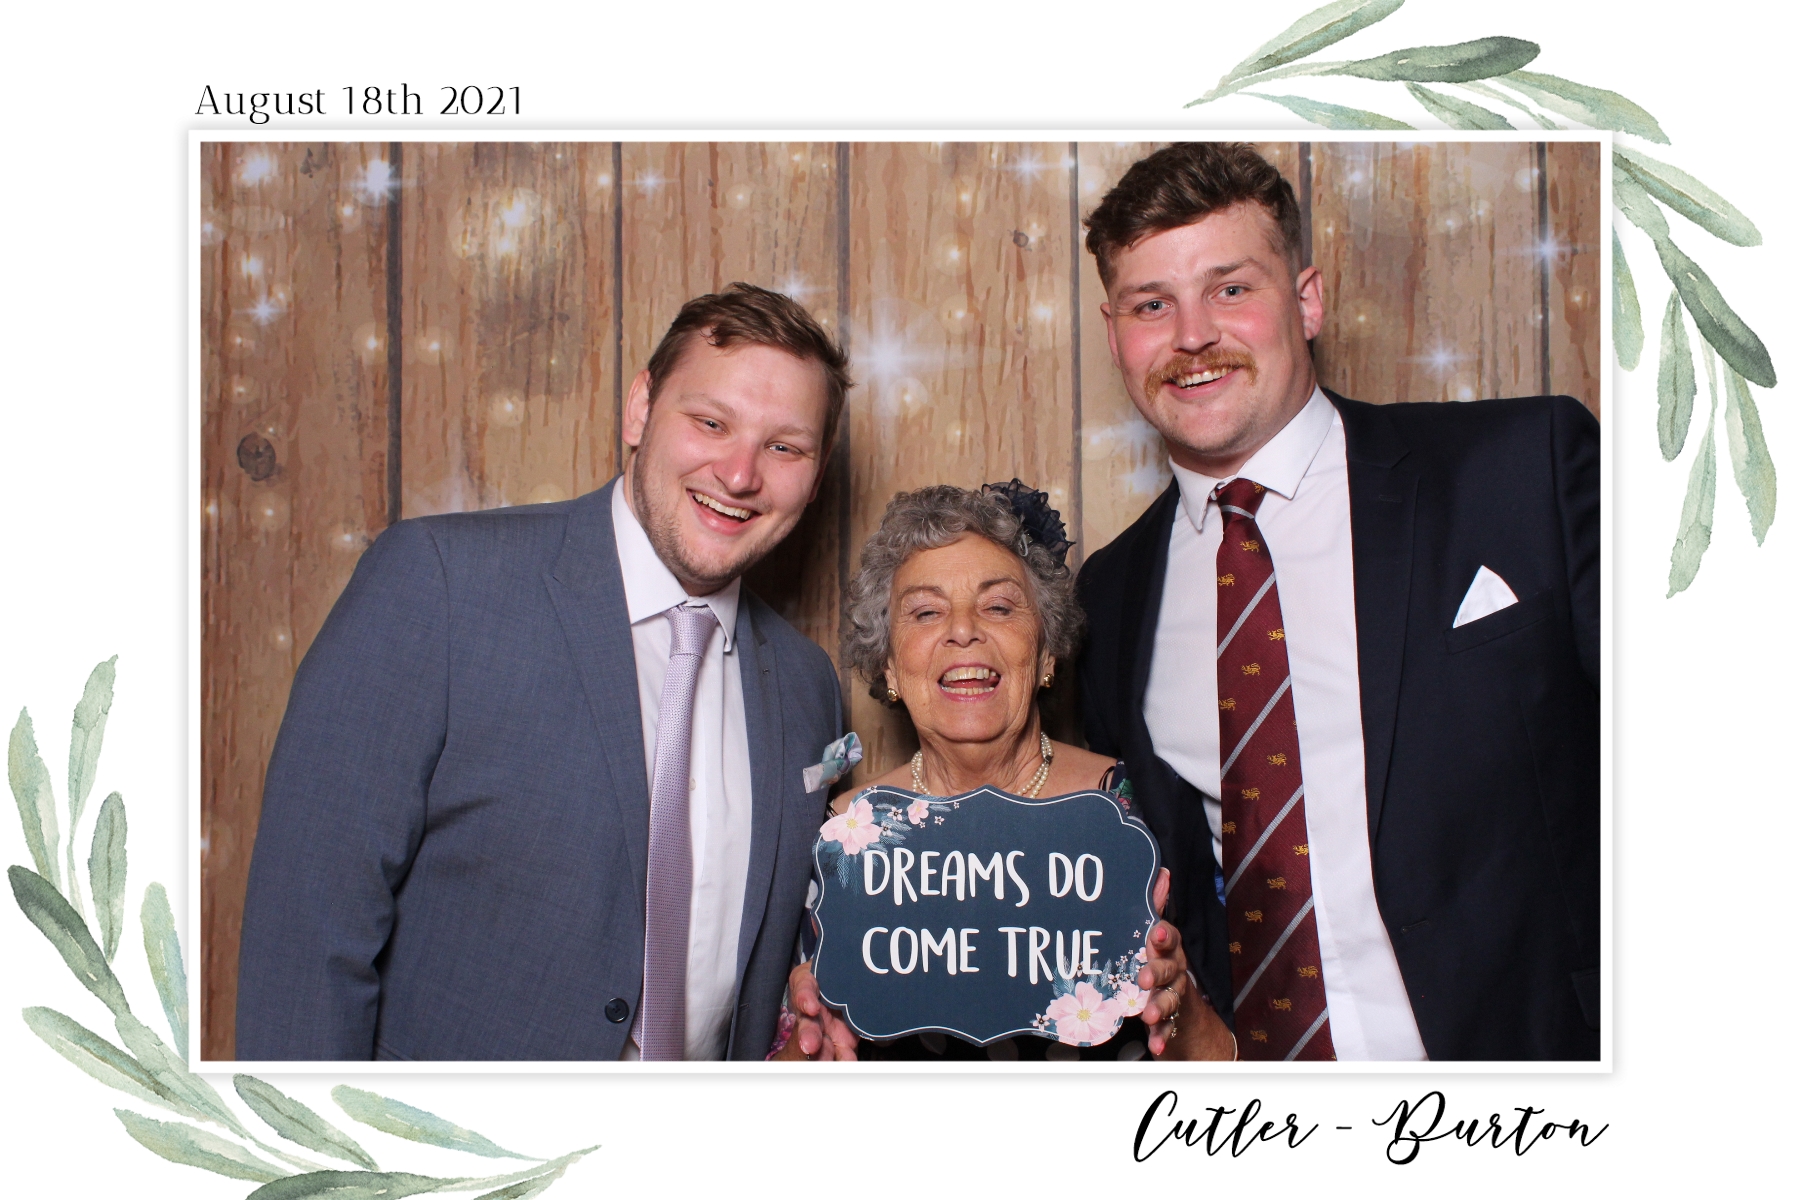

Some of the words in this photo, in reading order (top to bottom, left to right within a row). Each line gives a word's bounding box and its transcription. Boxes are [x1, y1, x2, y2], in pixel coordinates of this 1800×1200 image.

[863, 847, 1030, 908] DREAMS
[1048, 852, 1104, 902] DO
[862, 926, 980, 976] COME
[998, 926, 1103, 985] TRUE
